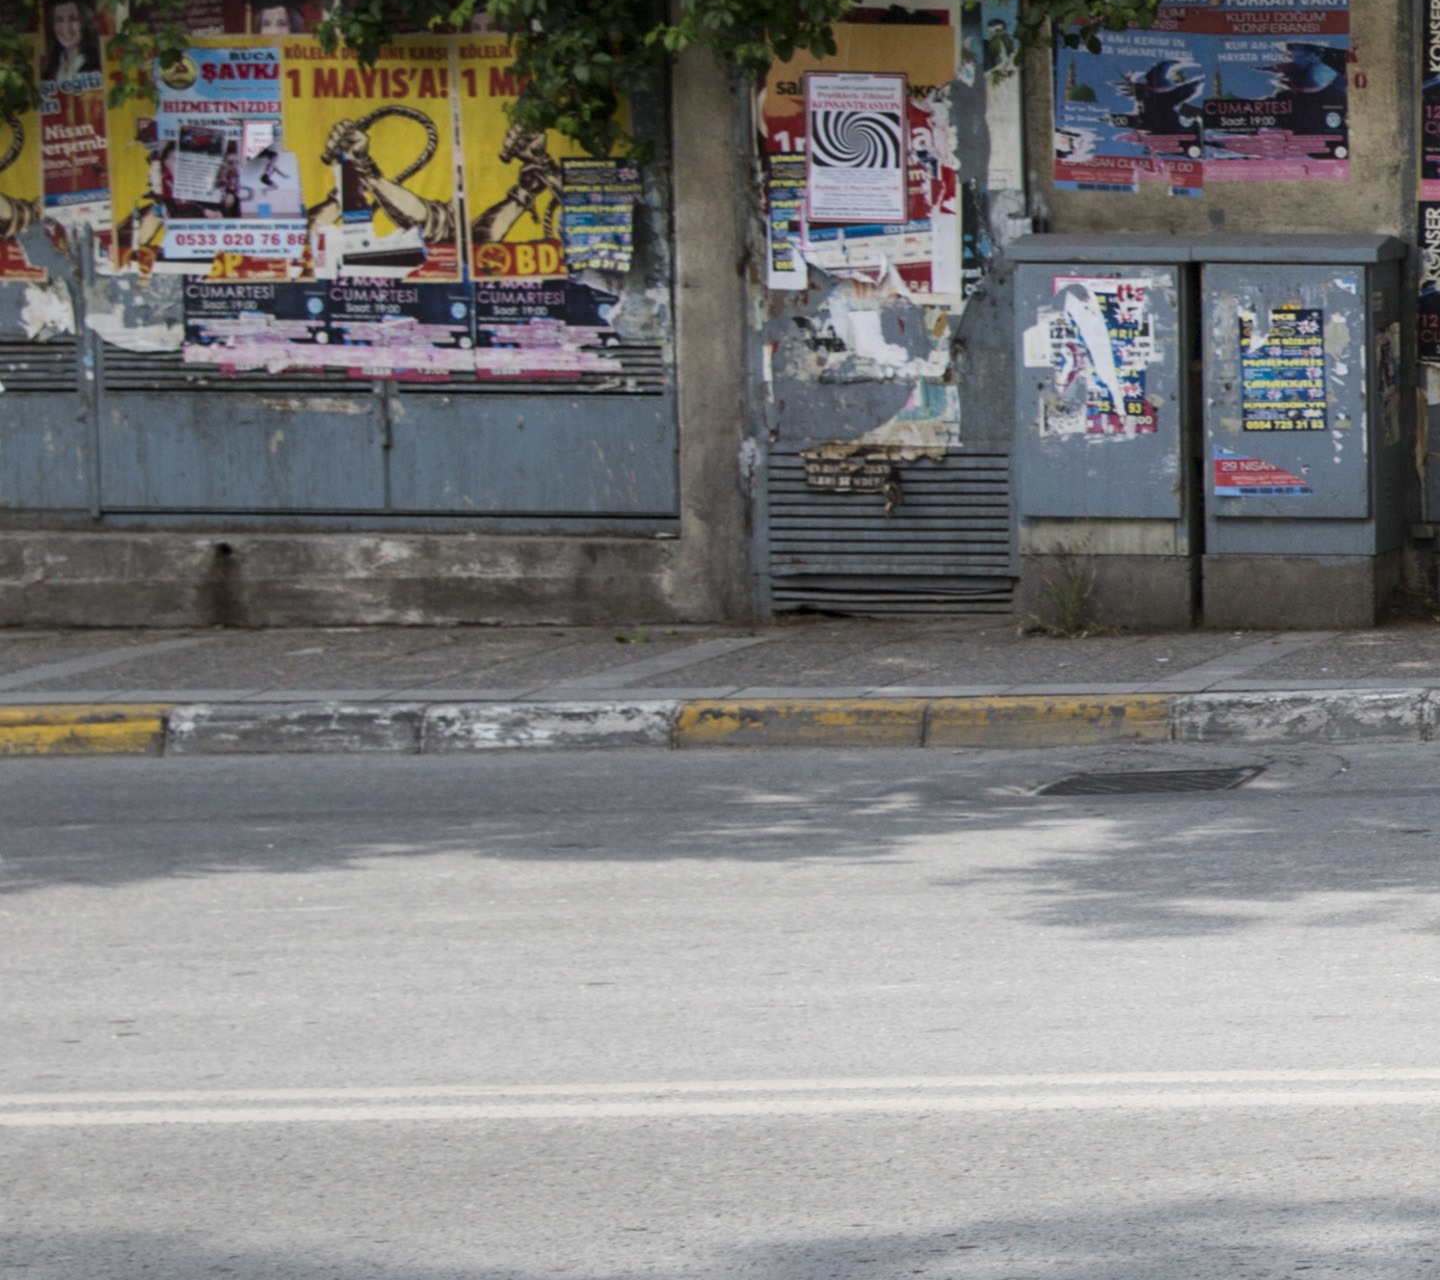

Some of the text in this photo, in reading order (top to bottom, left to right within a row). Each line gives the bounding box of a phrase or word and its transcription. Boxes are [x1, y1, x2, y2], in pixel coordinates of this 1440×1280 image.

[229, 52, 275, 61] BUCA
[287, 67, 448, 99] 1 MAYIS'A!
[462, 68, 477, 98] 1
[1206, 99, 1294, 115] CUMARTESİ
[45, 124, 95, 140] Nisan
[176, 233, 217, 246] 0533
[223, 233, 254, 246] 020
[261, 233, 281, 246] 76
[186, 284, 274, 299] CUMARTESİ
[330, 287, 418, 303] CUMARTESİ
[477, 290, 565, 305] CUMARTESİ
[1421, 314, 1438, 328] 12
[1221, 460, 1237, 471] 29
